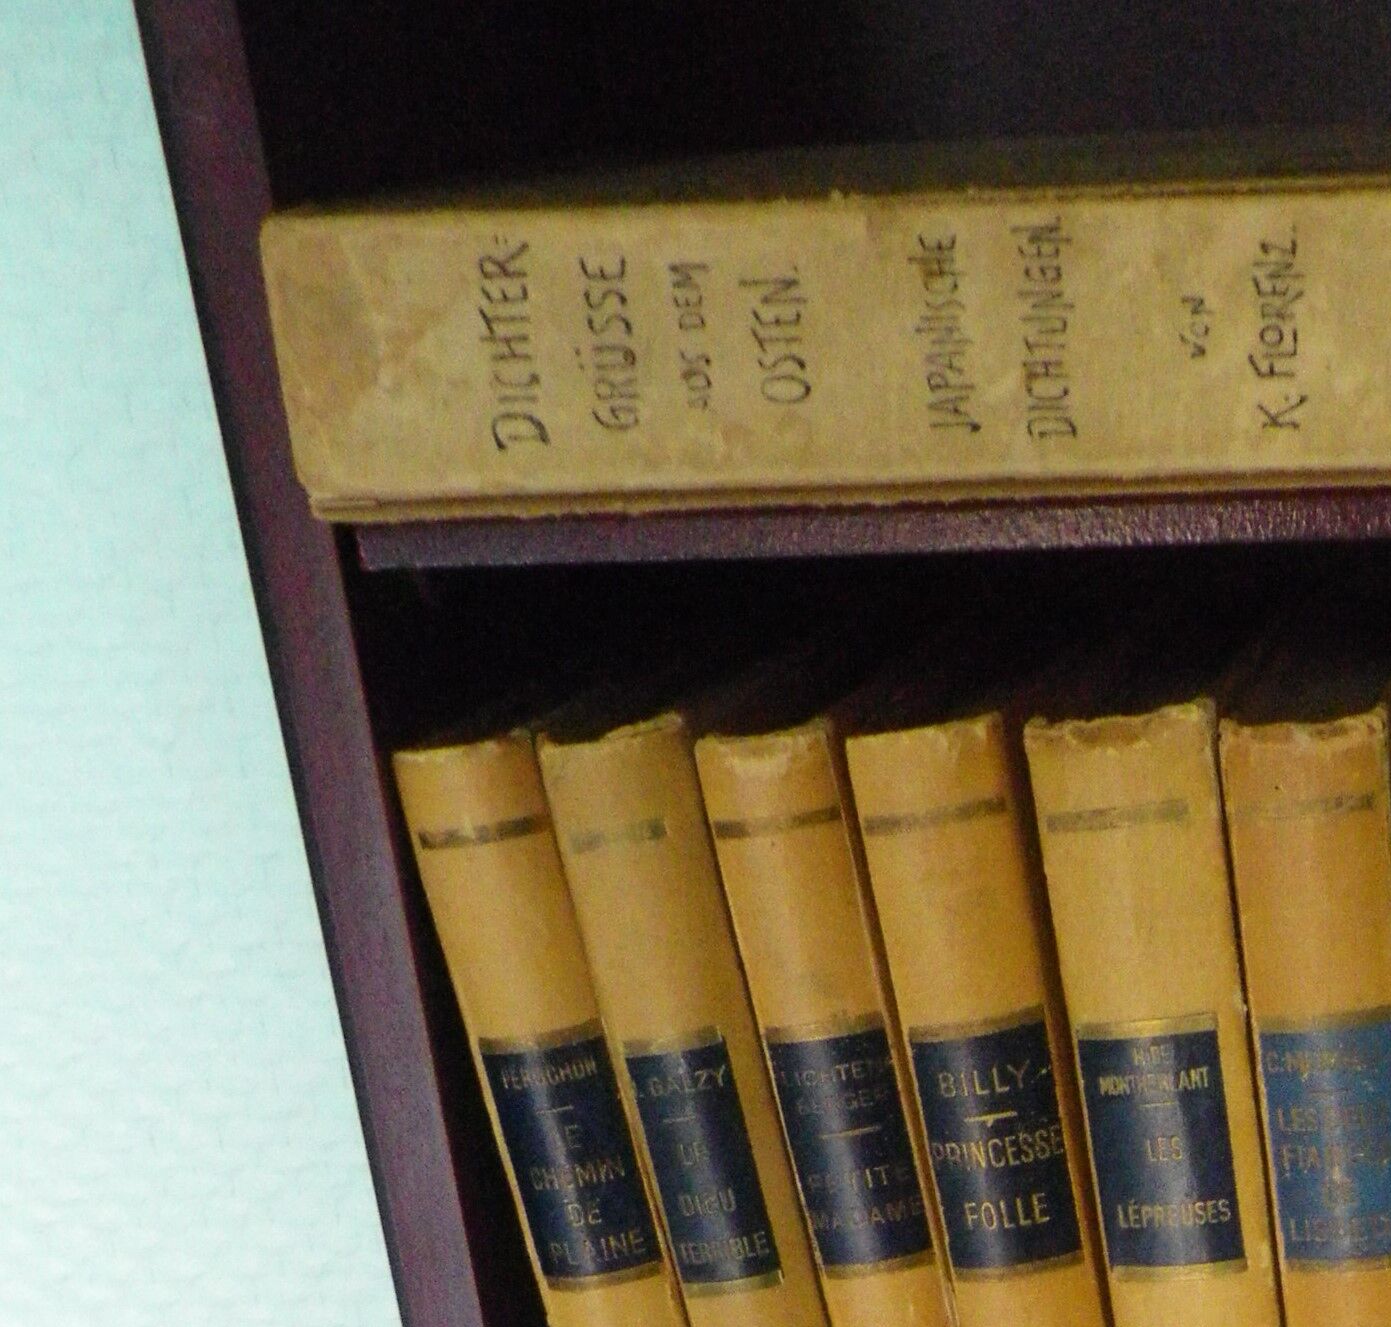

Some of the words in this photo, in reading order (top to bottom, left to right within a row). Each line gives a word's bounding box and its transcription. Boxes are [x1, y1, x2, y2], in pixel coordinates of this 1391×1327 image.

[666, 260, 711, 332] DEM
[907, 232, 981, 434] JAPANISCHE
[649, 1064, 727, 1098] GALZY
[936, 1060, 1031, 1099] BILLY
[931, 1125, 1065, 1172] PRINCESSE
[1146, 1134, 1184, 1161] LES
[963, 1193, 1051, 1232] FOLLE
[1117, 1198, 1233, 1230] LÉPREUSES
[550, 1232, 646, 1268] PLAINE
